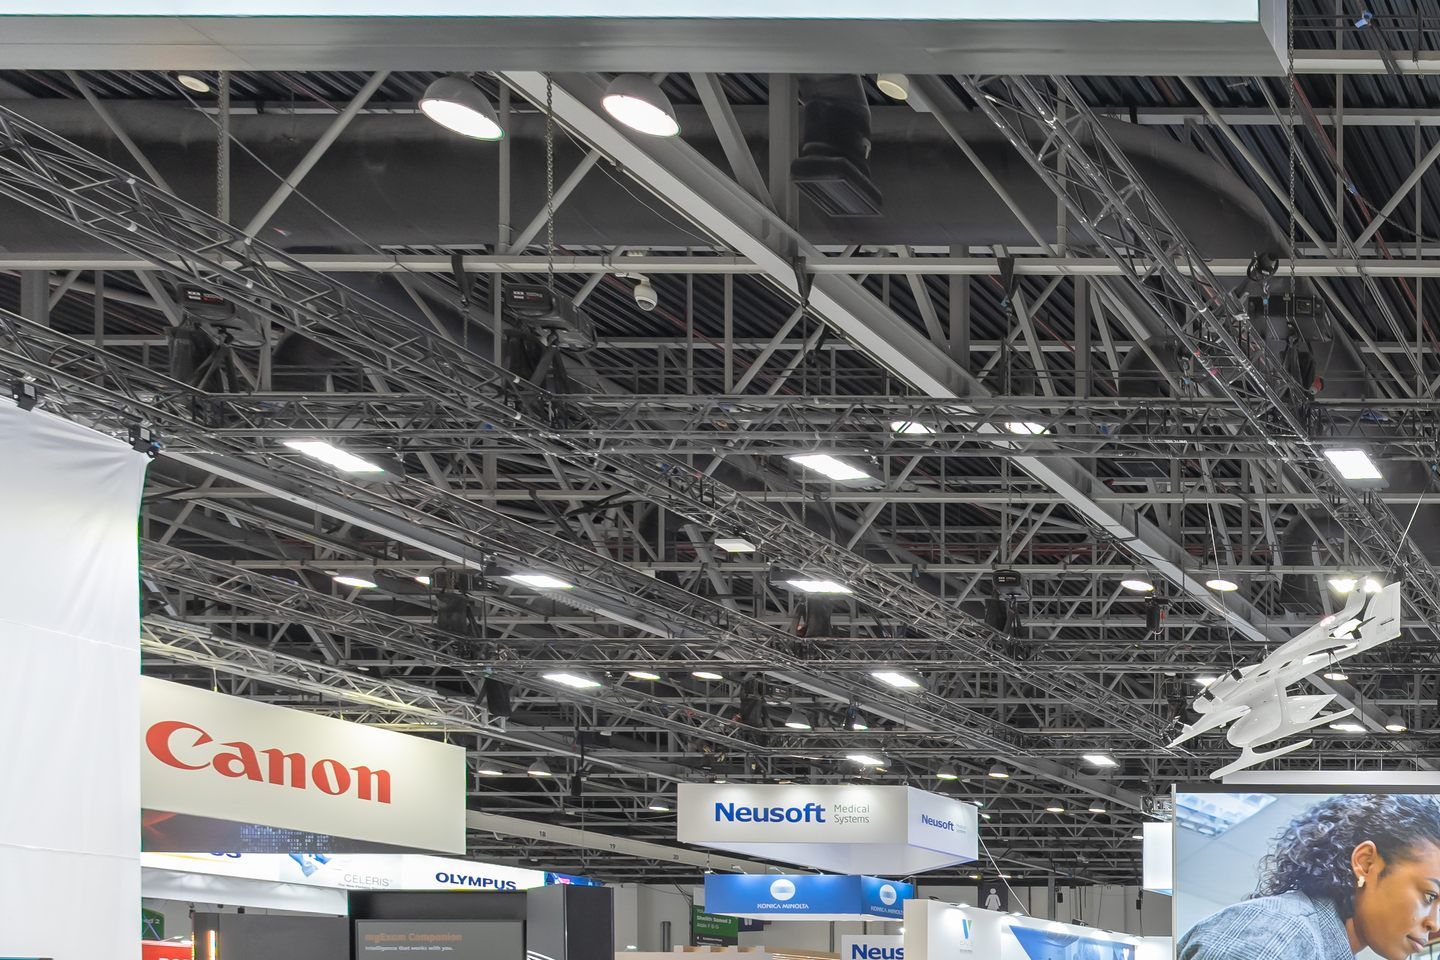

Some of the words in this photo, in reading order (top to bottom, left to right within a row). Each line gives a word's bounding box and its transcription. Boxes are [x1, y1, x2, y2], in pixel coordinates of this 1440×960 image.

[145, 720, 391, 804] Canon
[715, 802, 826, 823] Neusoft
[834, 804, 870, 813] Medical
[834, 815, 870, 824] Systems
[921, 814, 955, 831] Neusoft
[344, 873, 390, 887] CELERIS
[435, 872, 517, 891] OLYMPUS
[852, 943, 904, 960] Neus
